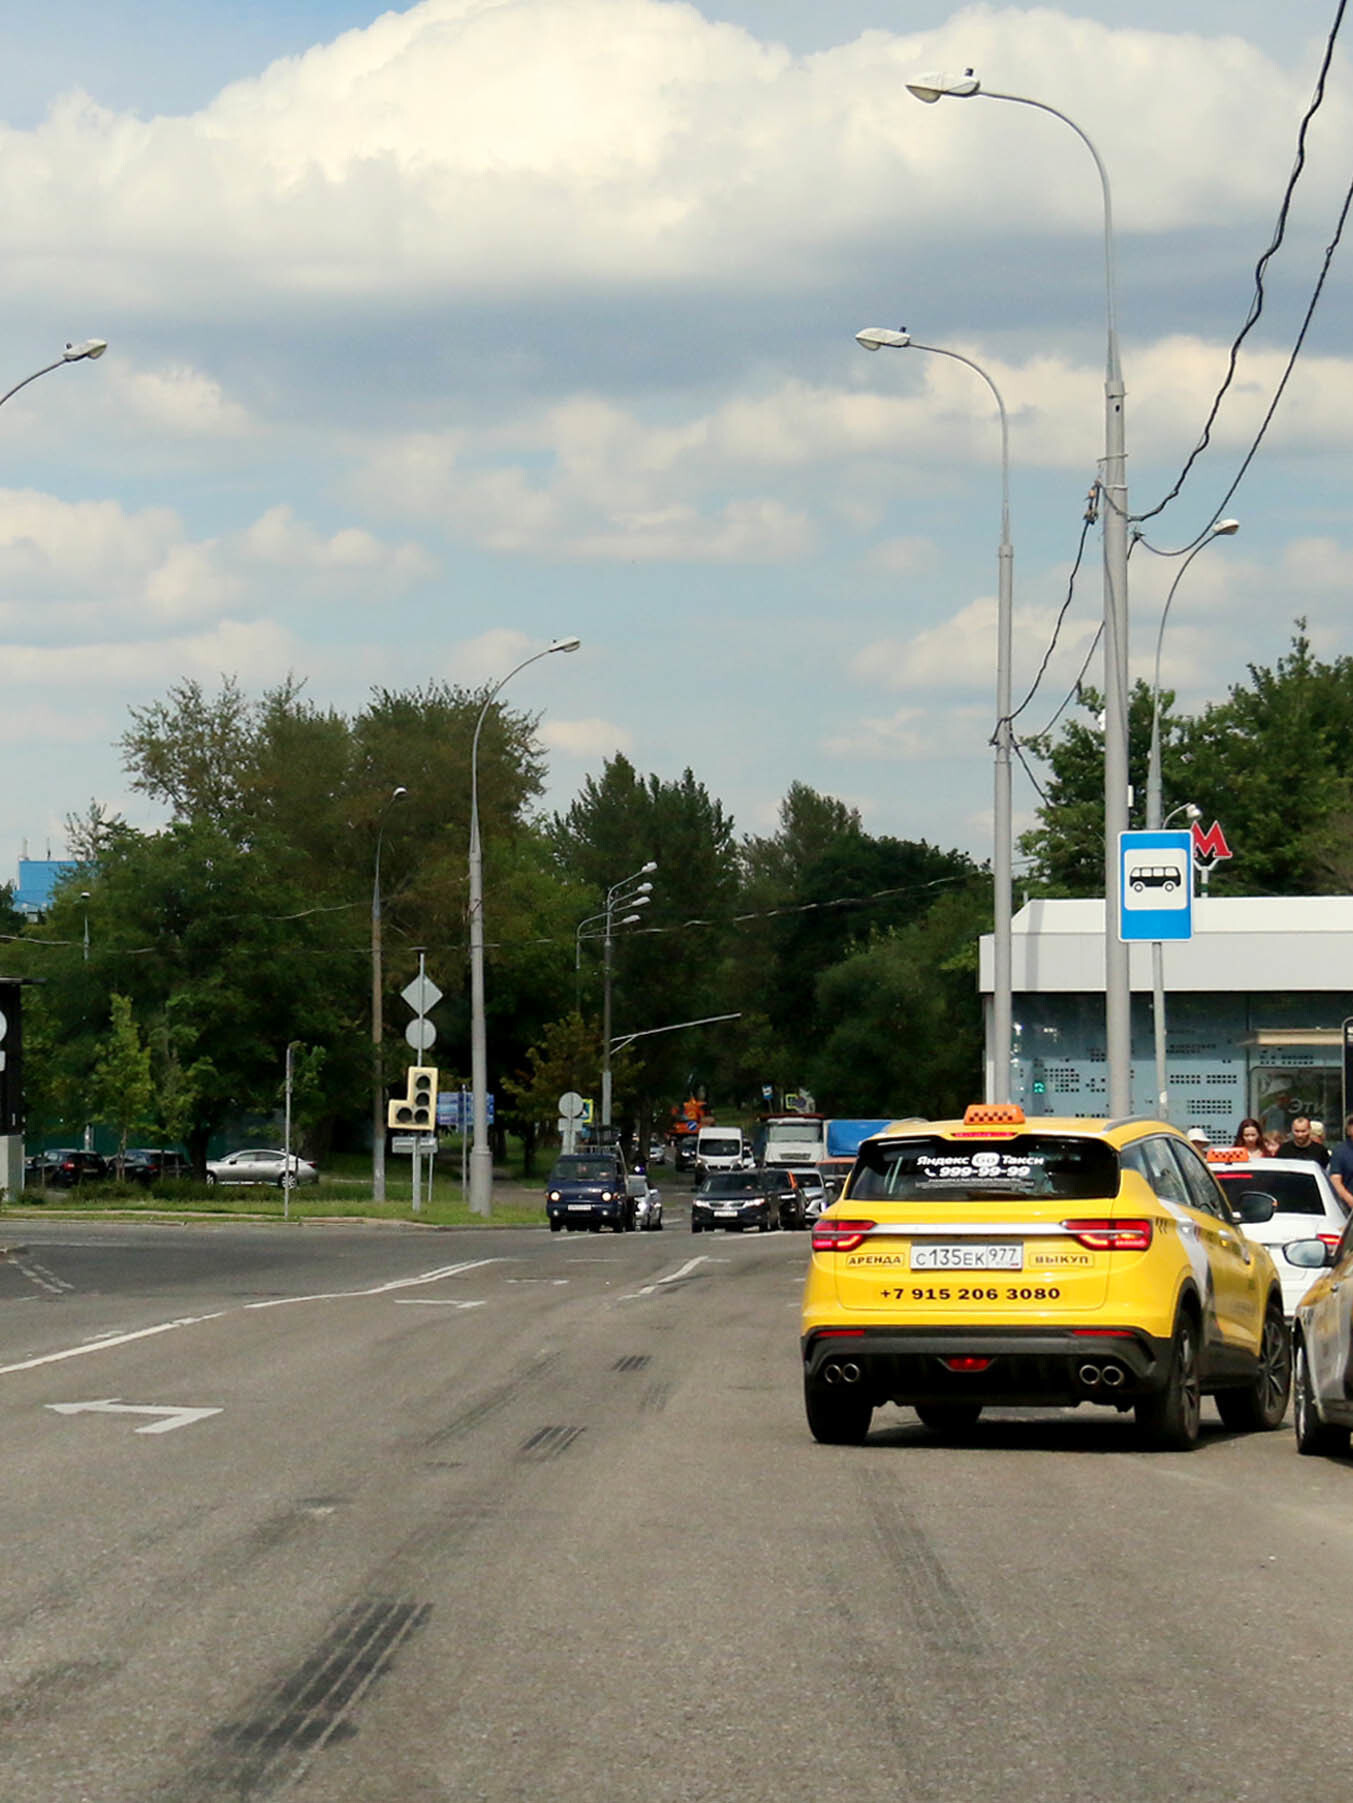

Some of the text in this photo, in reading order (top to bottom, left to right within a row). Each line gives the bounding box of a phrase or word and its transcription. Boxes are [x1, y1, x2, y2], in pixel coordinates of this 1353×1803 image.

[1191, 820, 1232, 858] М
[917, 1156, 970, 1166] Яндекс
[1002, 1155, 1044, 1165] Такси
[939, 1166, 1031, 1177] 999-99-99
[849, 1256, 901, 1264] АРЕНДА
[1035, 1256, 1088, 1264] ВЫКУП
[880, 1288, 1061, 1300] +7 915 206 3080
